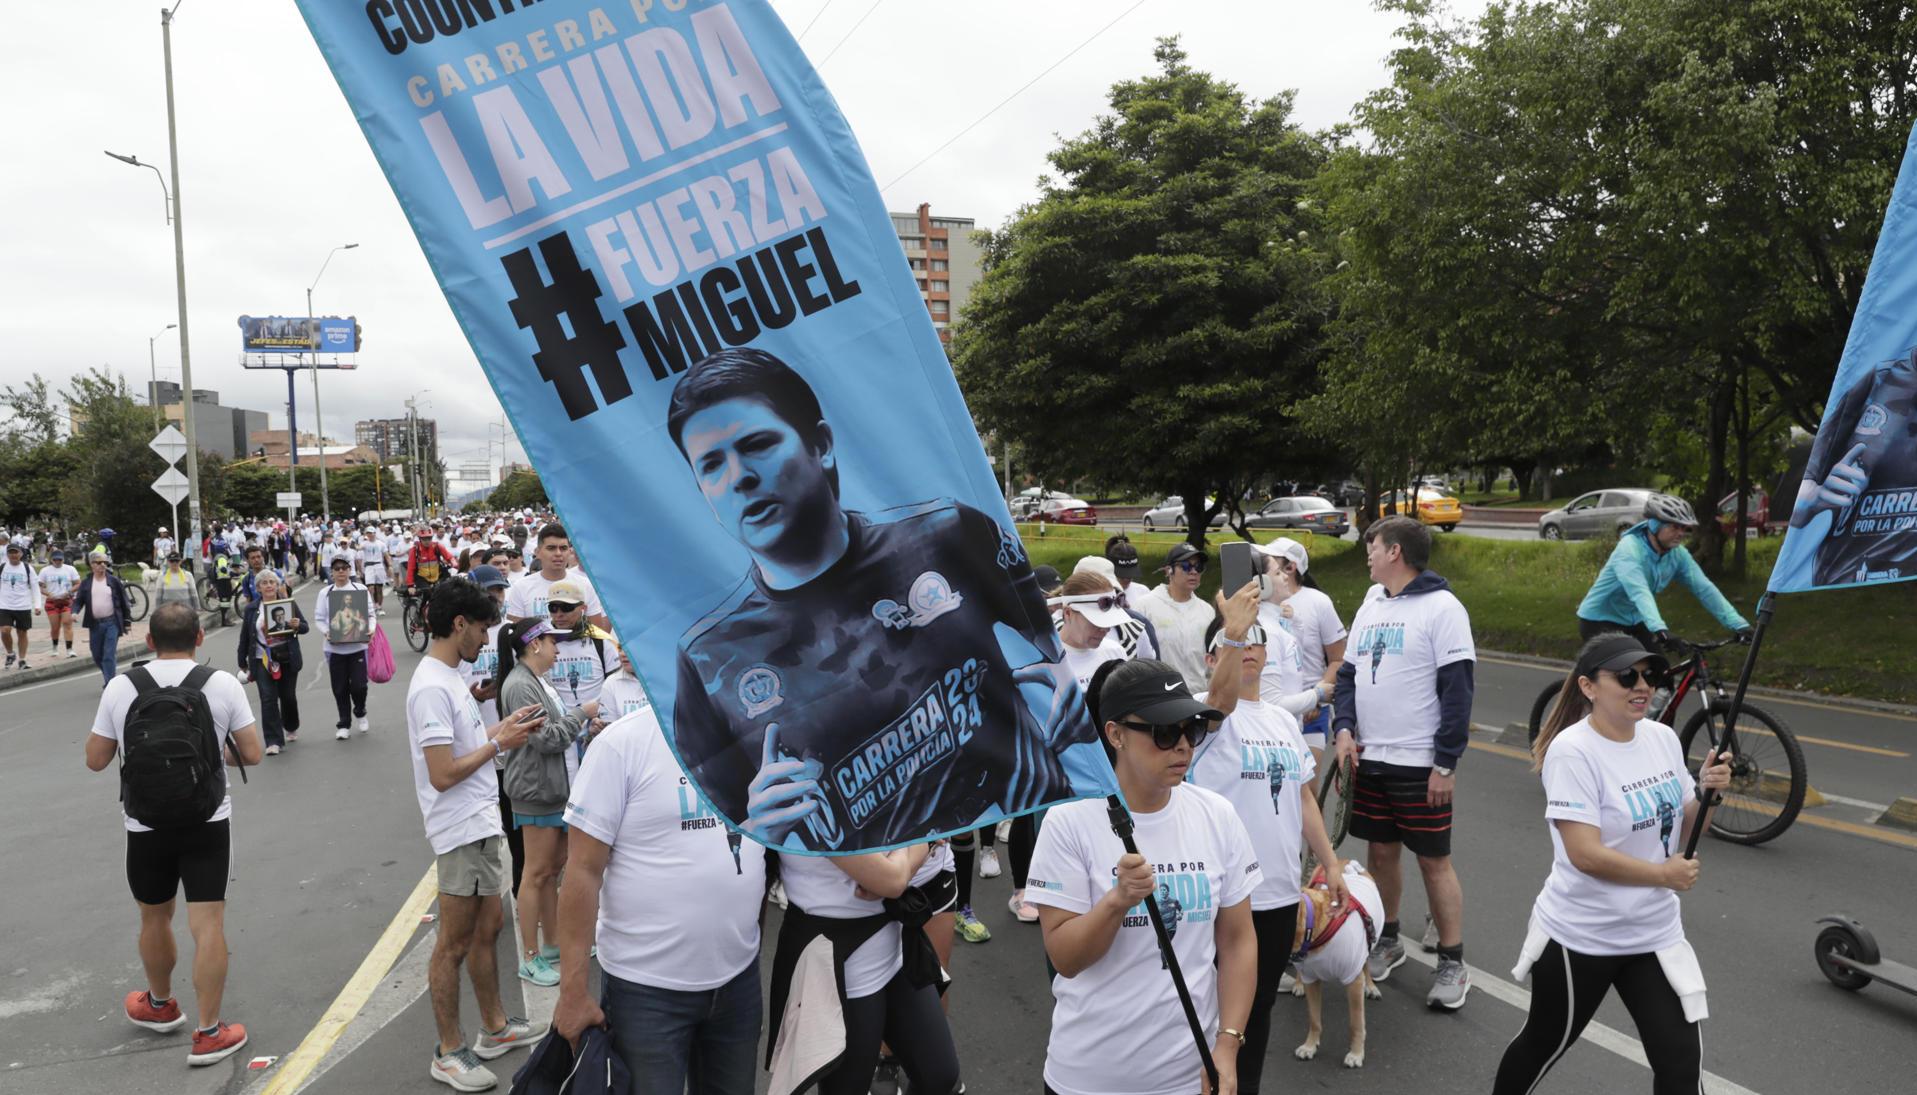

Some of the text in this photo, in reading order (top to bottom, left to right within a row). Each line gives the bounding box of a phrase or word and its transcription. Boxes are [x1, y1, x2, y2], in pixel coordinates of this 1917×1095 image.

[407, 7, 617, 108] CARRERA
[418, 2, 782, 231] LA VIDA
[584, 145, 829, 304] FUERZA
[622, 225, 862, 382] MIGUEL
[281, 337, 313, 345] ESTAD
[1853, 519, 1876, 533] POR
[1877, 518, 1892, 532] LA
[836, 692, 945, 799] CARRERA
[1240, 744, 1265, 771] LA
[850, 790, 878, 824] POR
[877, 776, 897, 802] LA
[1623, 790, 1656, 822] LA
[680, 818, 717, 831] #FUERZA
[1111, 861, 1205, 877] CERA POR
[1122, 915, 1149, 928] UERZA
